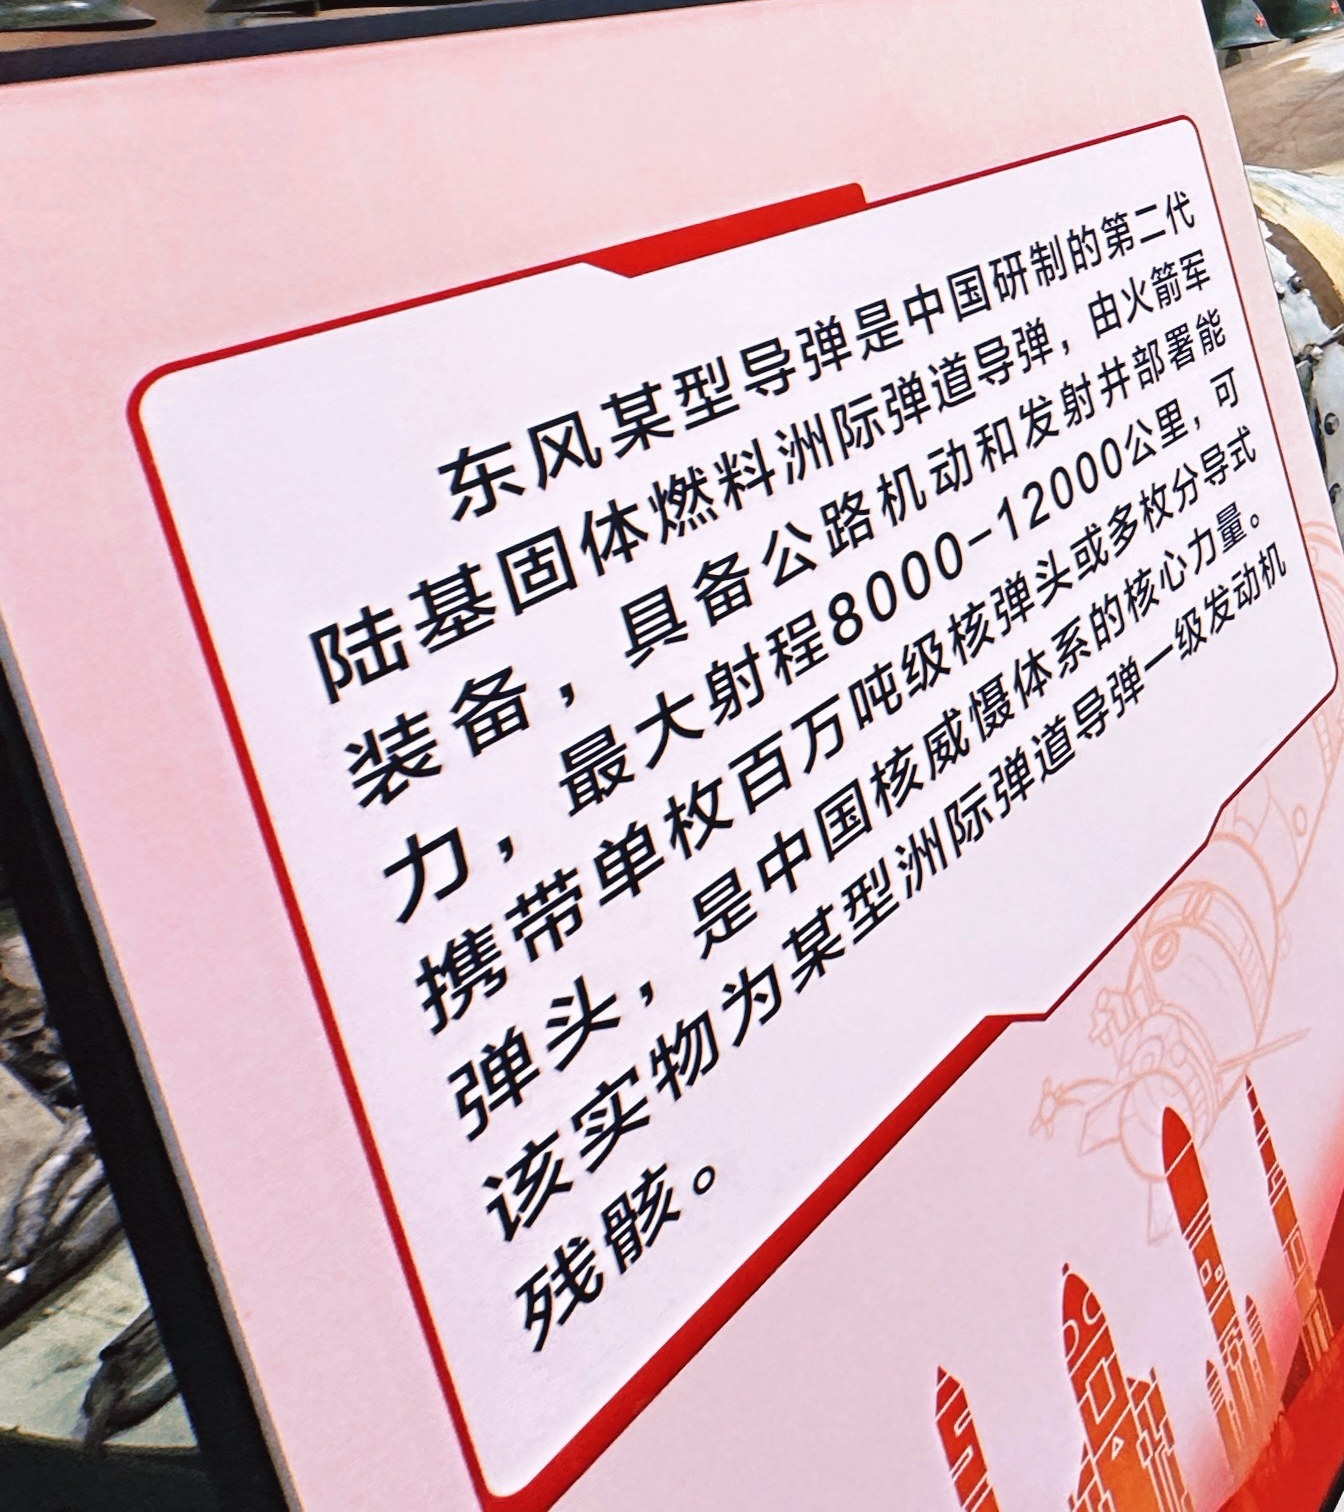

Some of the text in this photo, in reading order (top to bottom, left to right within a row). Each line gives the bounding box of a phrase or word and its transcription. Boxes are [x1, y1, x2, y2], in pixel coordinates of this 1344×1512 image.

[308, 249, 1212, 704] 陆基固体燃料洲际弹道导弹，由火箭军
[344, 307, 1228, 811] 装备，具备公路机动和发射井部署能
[437, 189, 1197, 523] 东风某型导弹是中国研制的第二代
[414, 425, 1256, 1035] 携带单枚百万吨级核弹头或多枚分导式
[448, 508, 1263, 1142] 弹头，是中国核威慑体系的核心力量。
[481, 545, 1288, 1244] 该实物为某型洲际弹道导弹一级发动机
[513, 1161, 718, 1354] 残骸。
